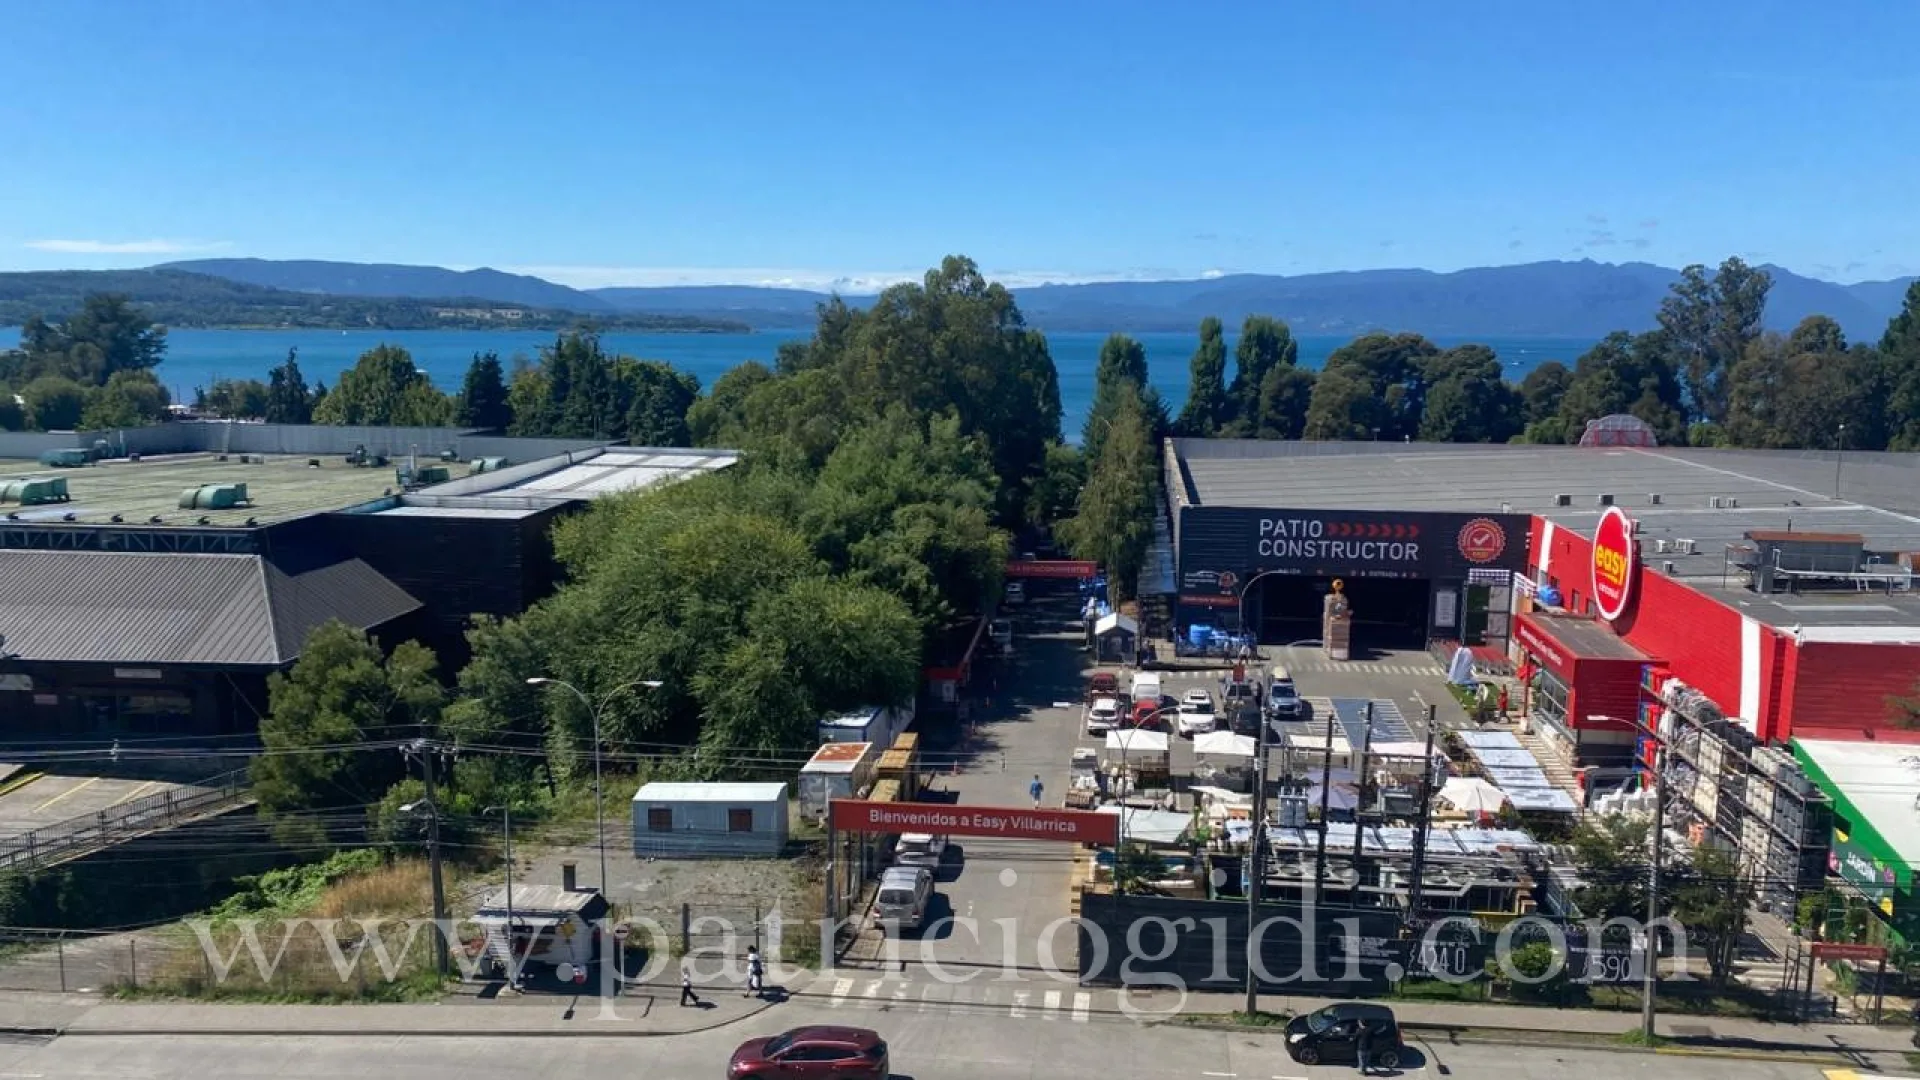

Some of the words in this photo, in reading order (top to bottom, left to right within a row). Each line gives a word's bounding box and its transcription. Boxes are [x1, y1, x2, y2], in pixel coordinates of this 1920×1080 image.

[1259, 518, 1323, 538] PATIO
[1258, 540, 1419, 561] CONSTRUCTOR
[1596, 544, 1627, 586] easy
[869, 809, 956, 826] Bienvenidos
[960, 817, 970, 826] a
[973, 814, 1008, 831] Easy
[1011, 816, 1077, 832] Villarrica
